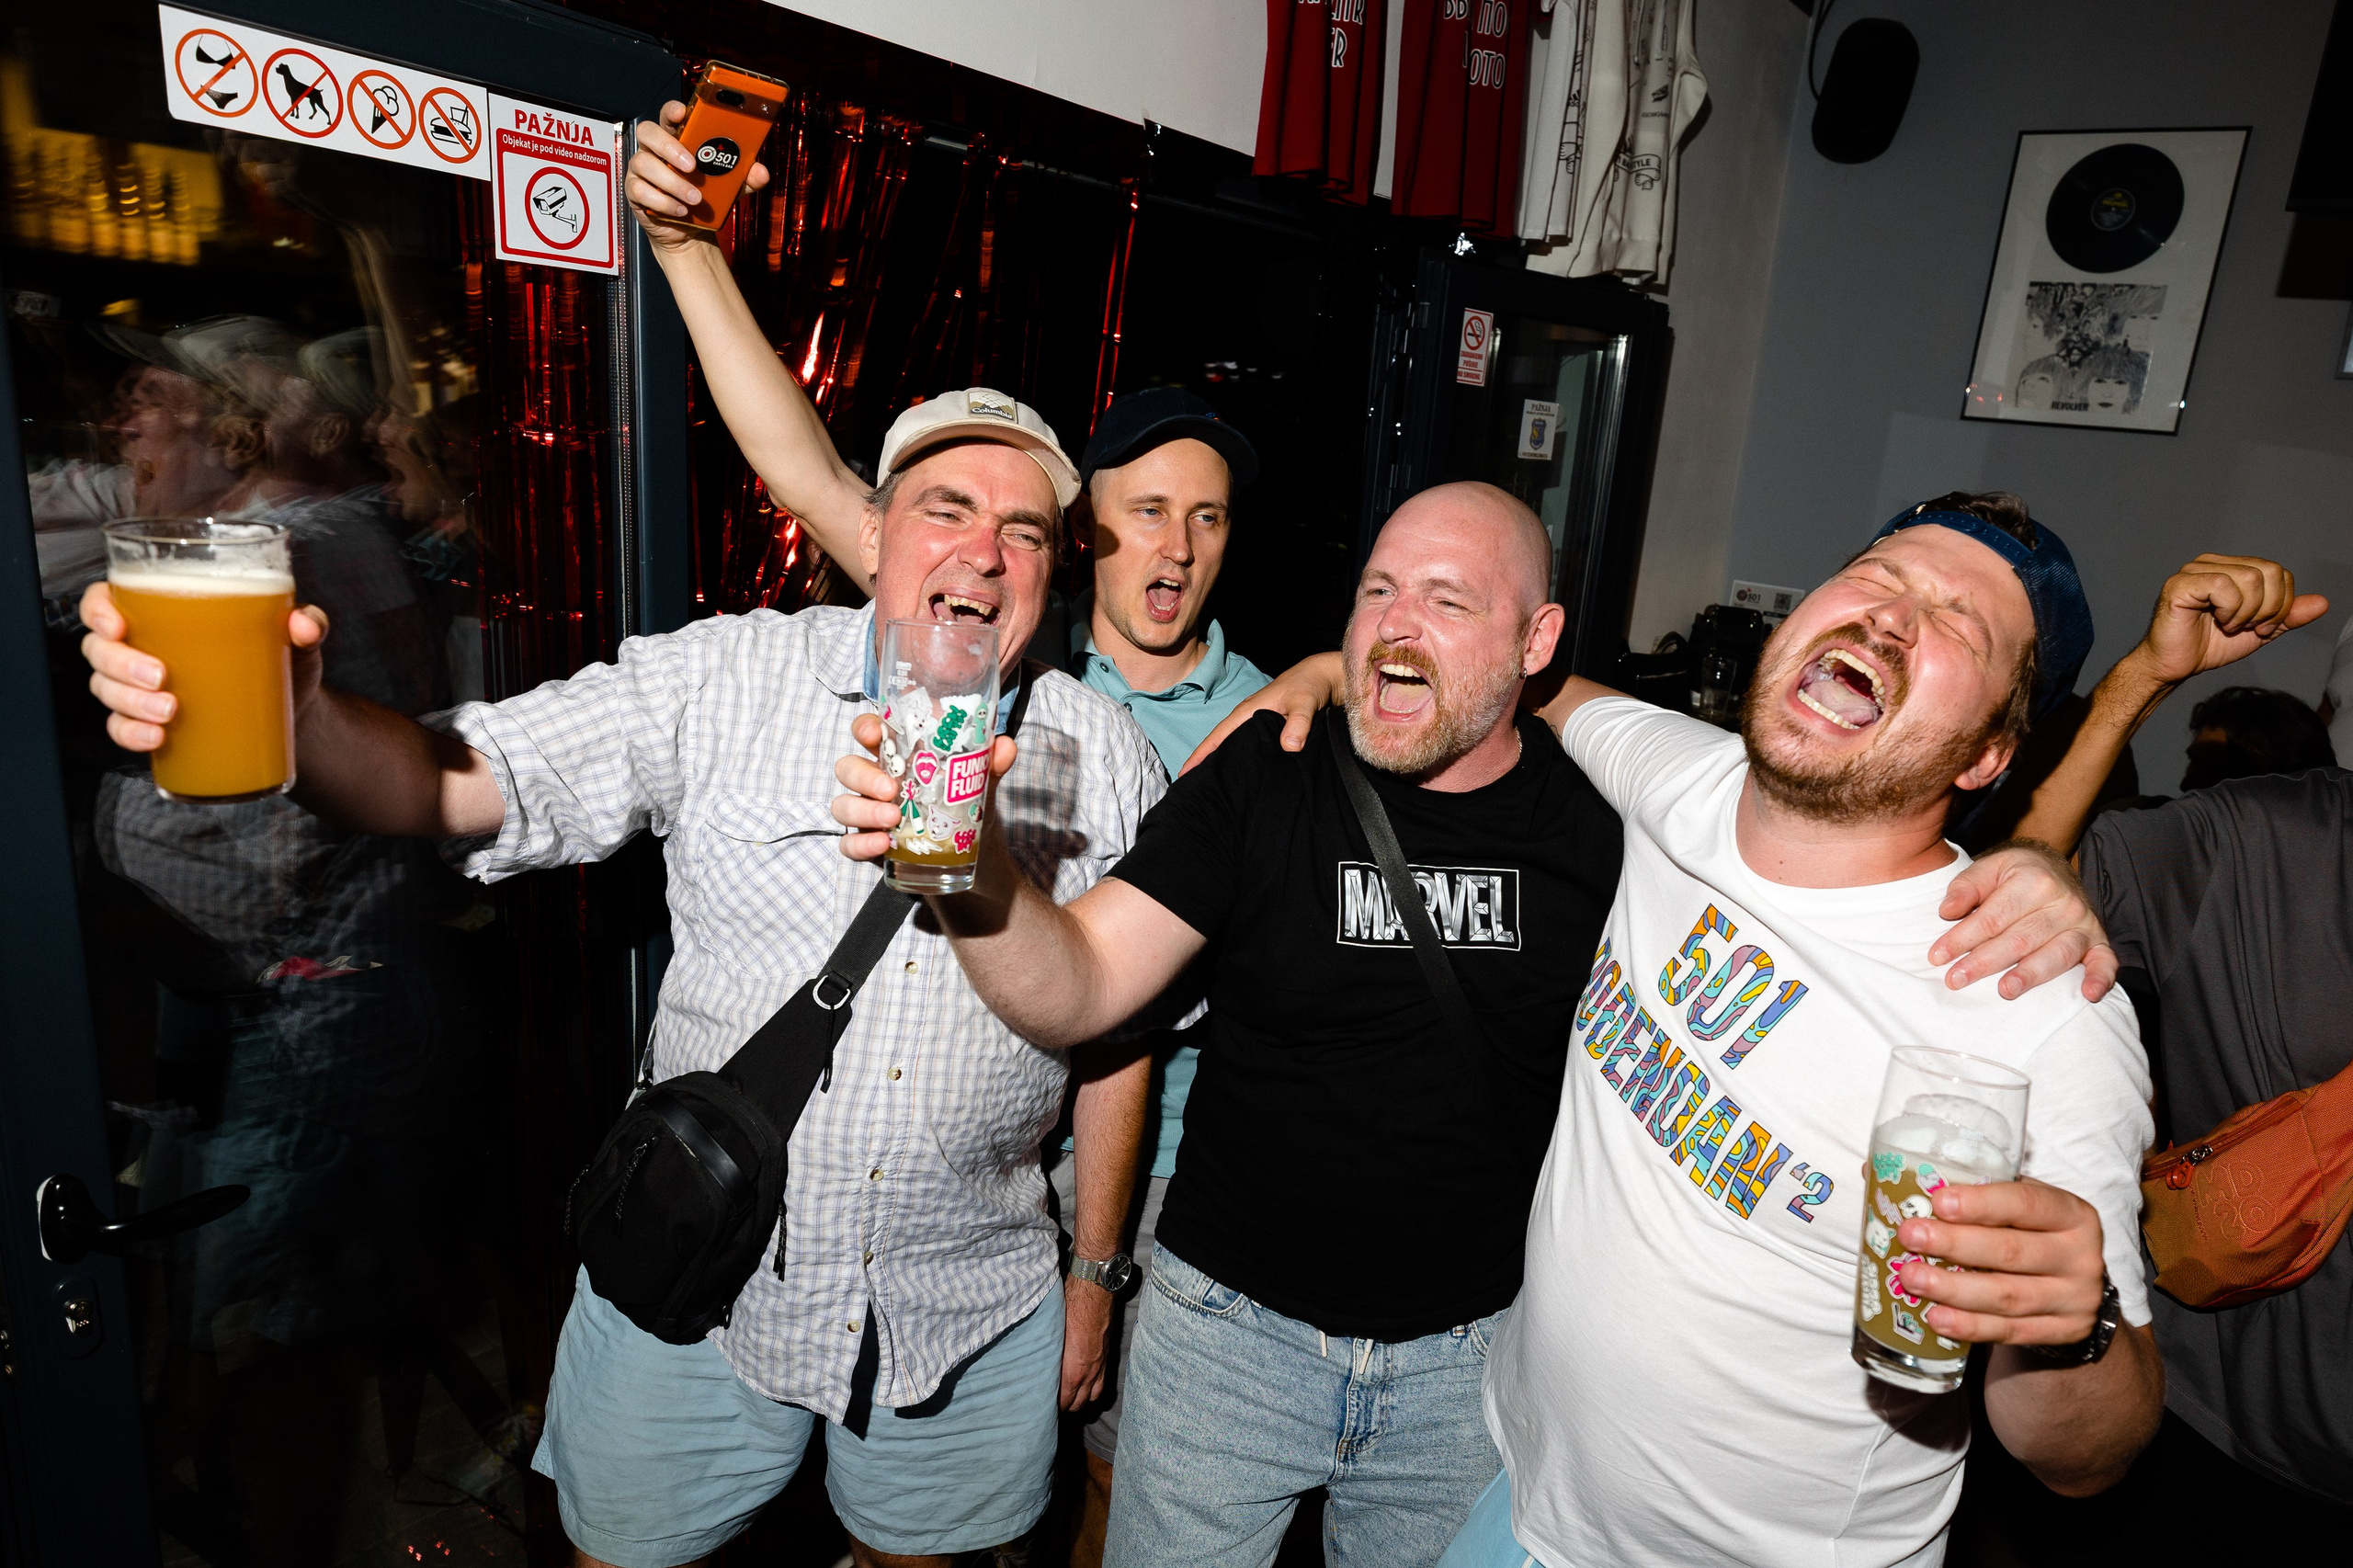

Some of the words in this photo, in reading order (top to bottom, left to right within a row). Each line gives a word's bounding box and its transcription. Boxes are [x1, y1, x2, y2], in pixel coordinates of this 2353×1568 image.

[515, 109, 595, 146] PAŽNJA
[502, 133, 531, 151] Objekat
[531, 140, 539, 153] je
[540, 142, 553, 155] pod
[554, 146, 574, 158] video
[574, 151, 607, 166] nadzorom
[715, 152, 738, 165] 501
[972, 407, 1013, 419] Columbia
[2051, 401, 2089, 412] REVOLVER
[952, 754, 989, 779] FUNK
[950, 772, 985, 798] FLUID
[1658, 903, 1809, 1070] 501
